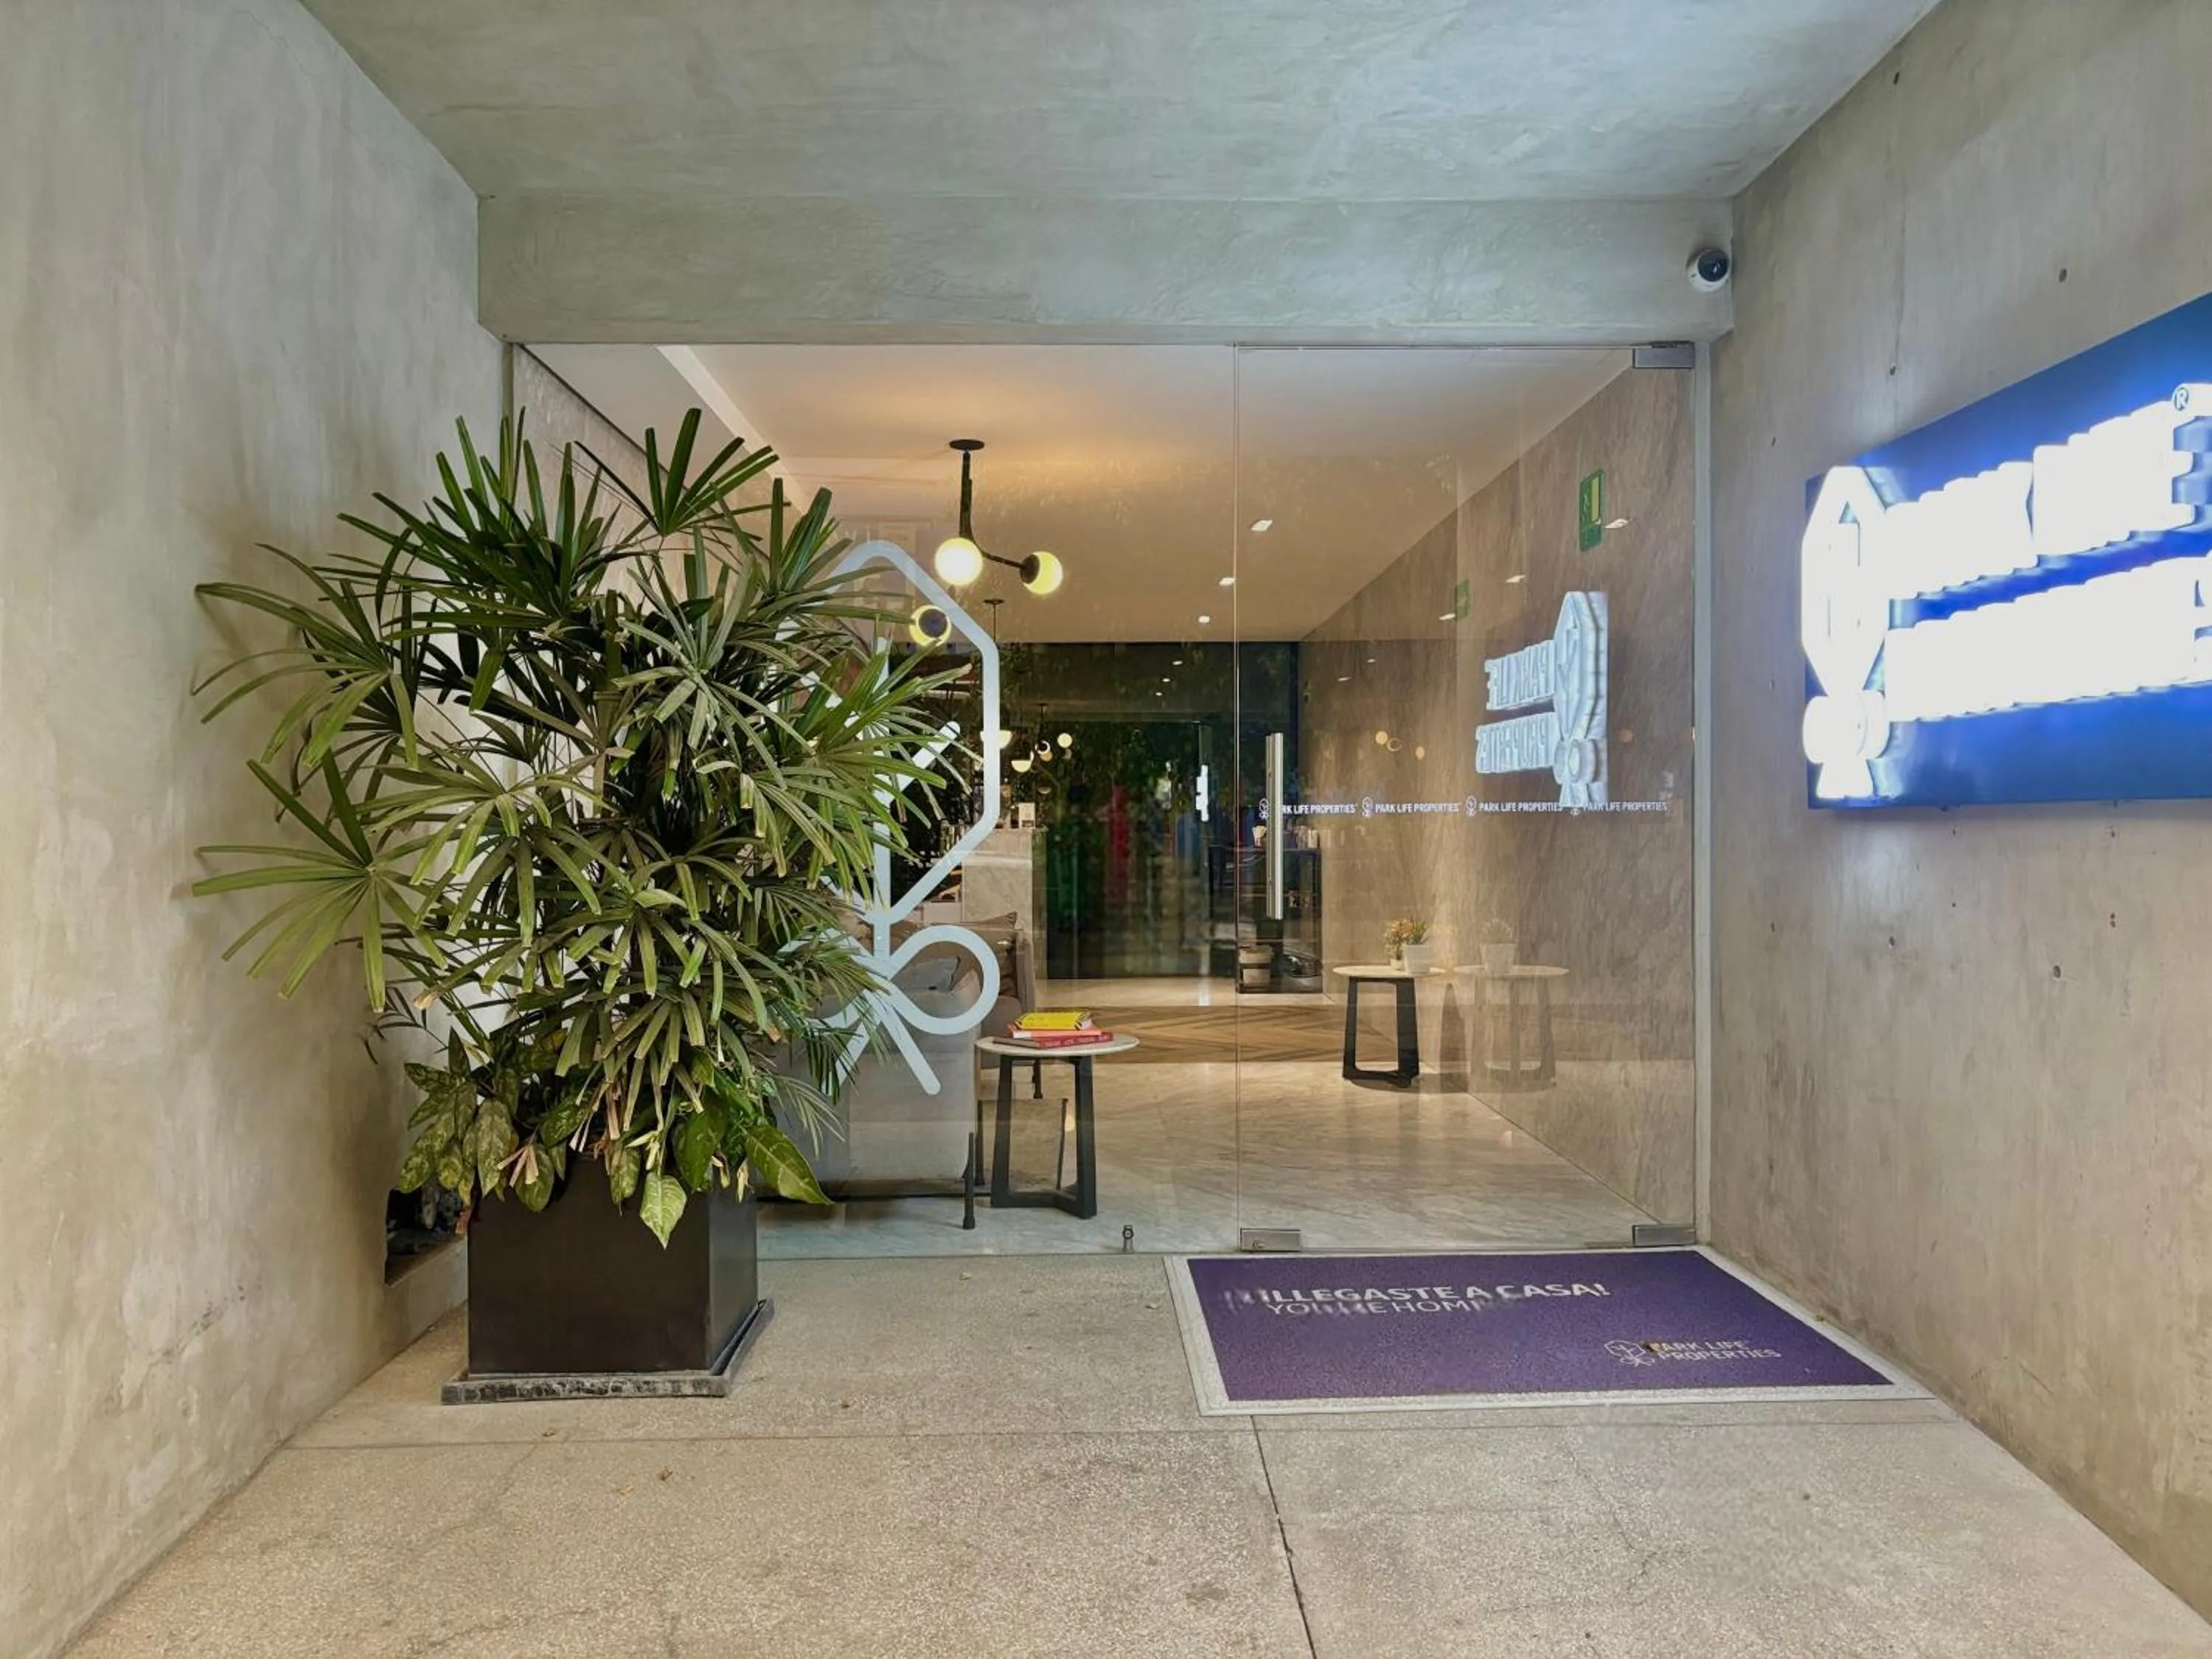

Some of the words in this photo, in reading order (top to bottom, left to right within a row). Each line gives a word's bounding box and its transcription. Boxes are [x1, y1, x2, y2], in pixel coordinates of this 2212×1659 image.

[1293, 804, 1309, 814] LIFE
[1310, 803, 1355, 814] PROPERTIES
[1375, 802, 1396, 813] PARK
[1397, 802, 1413, 813] LIFE
[1413, 801, 1459, 813] PROPERTIES
[1479, 801, 1500, 812] PARK
[1501, 801, 1517, 812] LIFE
[1518, 801, 1563, 812] PROPERTIES
[1606, 801, 1621, 812] LIFE
[1623, 801, 1668, 812] PROPERTIES
